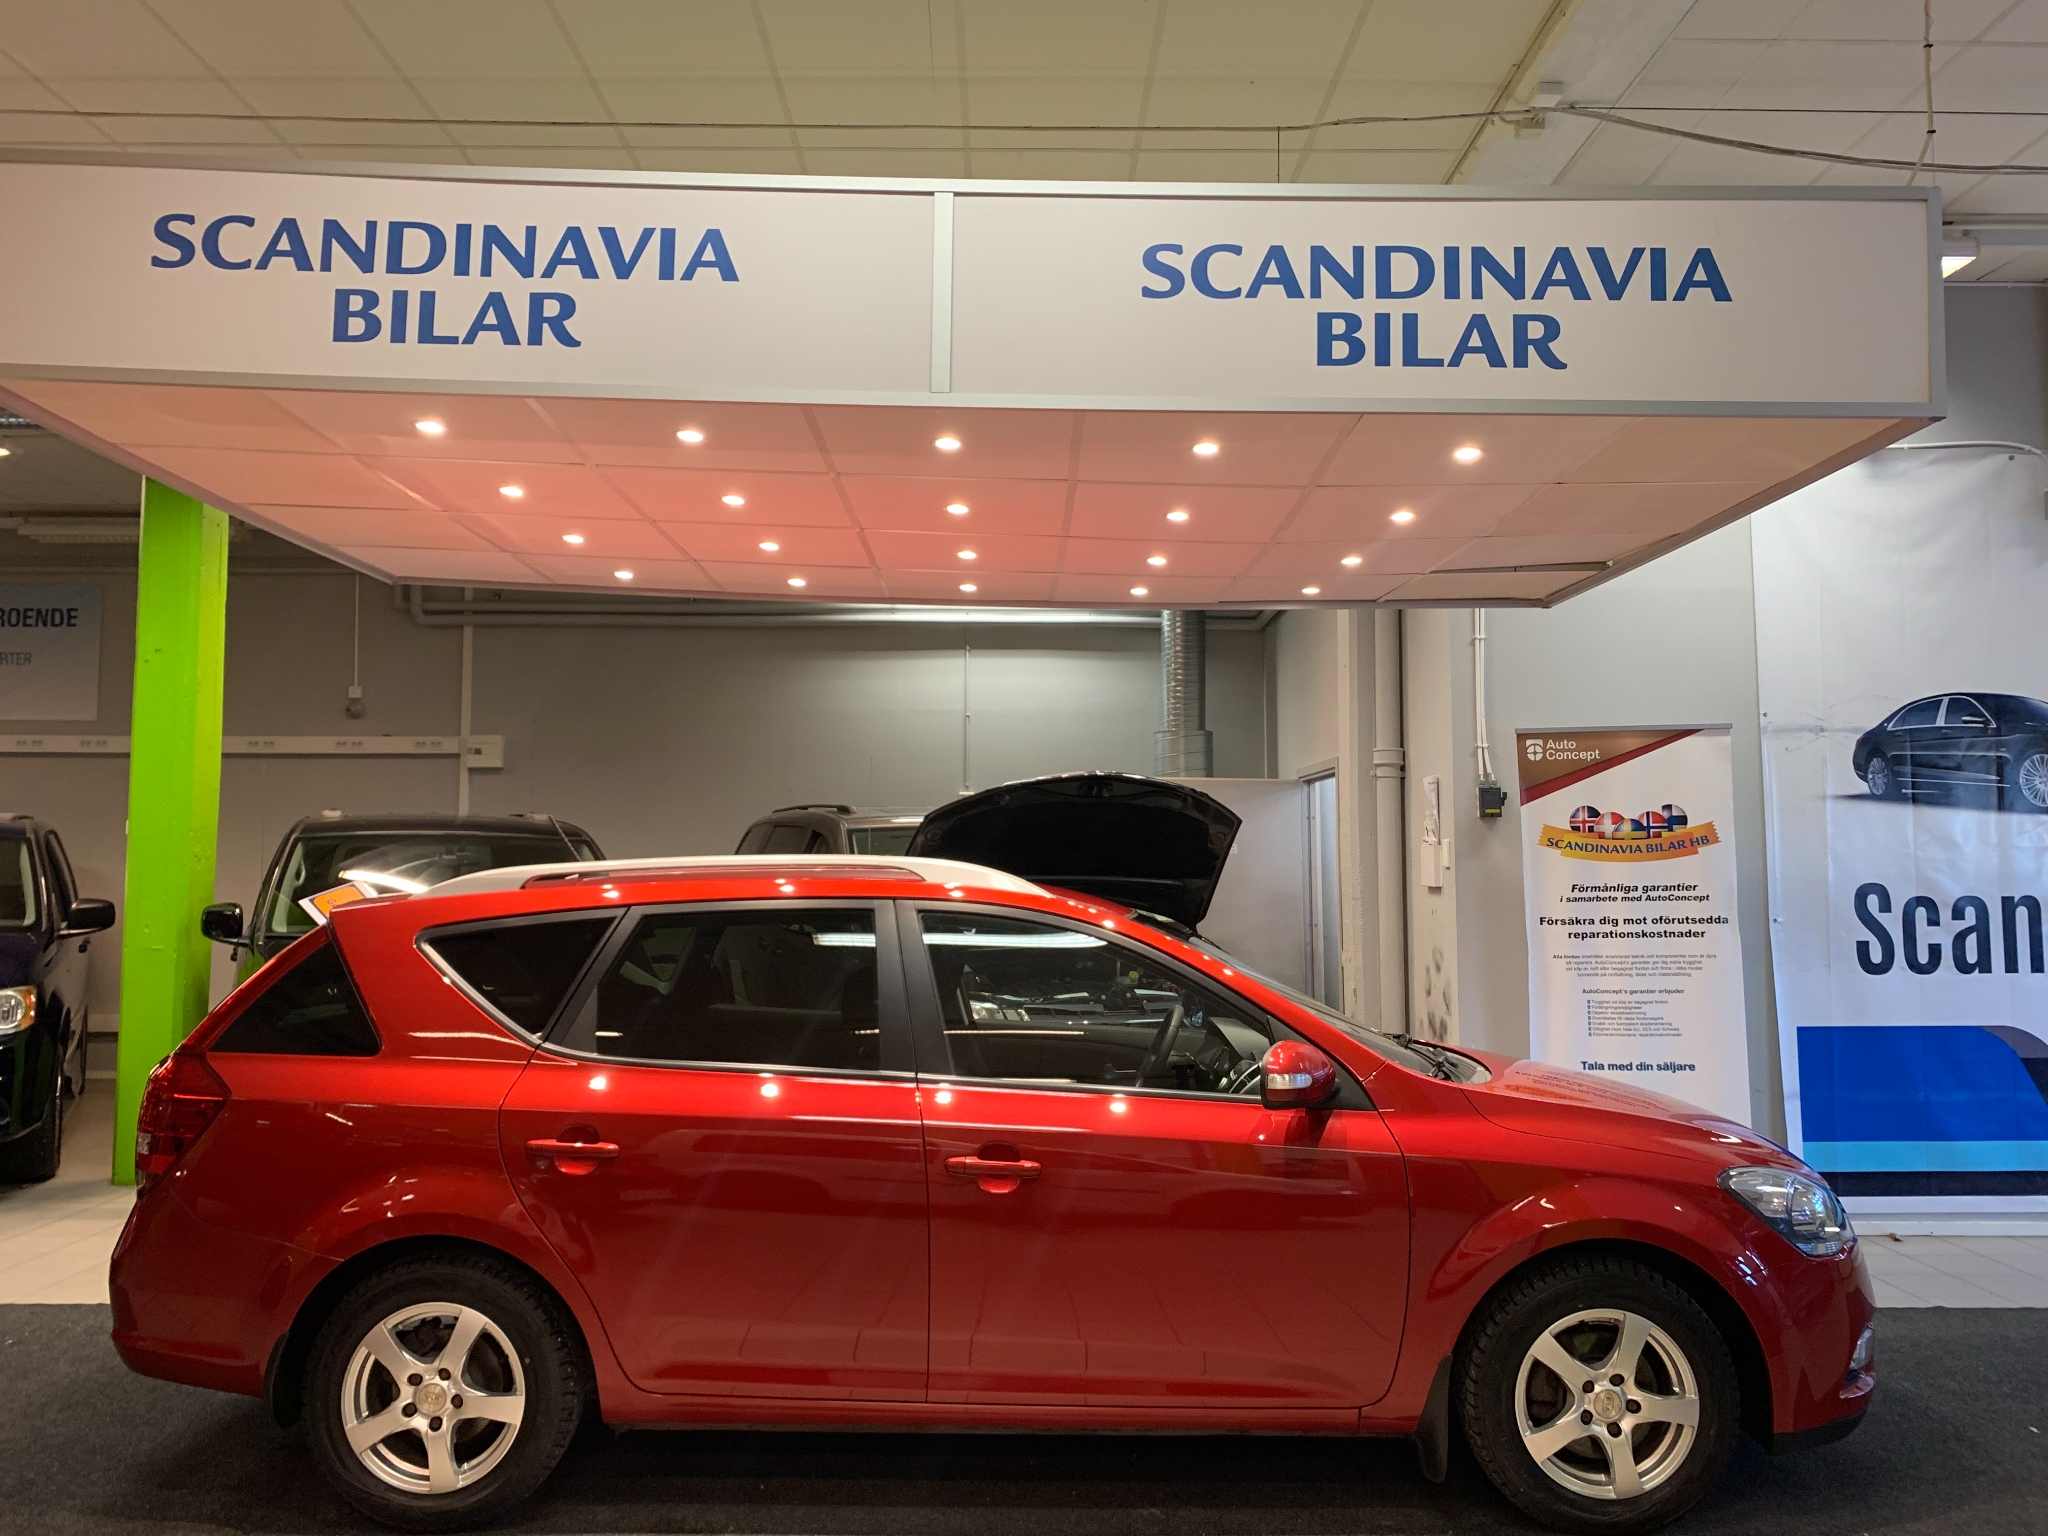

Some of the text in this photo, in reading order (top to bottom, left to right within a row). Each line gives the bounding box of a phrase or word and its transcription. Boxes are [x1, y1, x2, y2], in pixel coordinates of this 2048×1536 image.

[151, 213, 739, 282] SCANDINAVIA
[1142, 244, 1733, 302] SCANDINAVIA
[332, 288, 582, 348] BILAR
[1316, 311, 1568, 371] BILAR
[1546, 738, 1577, 749] Auto
[1546, 749, 1601, 762] Concept
[1546, 835, 1710, 854] SCANDINAVIA BILAR HB
[1571, 883, 1699, 893] Förmånliga garantier
[1565, 894, 1619, 903] samarbete
[1620, 894, 1643, 902] med
[1644, 893, 1710, 903] AutoConcept
[1539, 915, 1729, 928] Försäkra dig mot oförutsedda
[1567, 929, 1706, 942] reparationskostnader
[1853, 882, 2045, 976] Scan
[1580, 1061, 1696, 1074] Tala med din säljare
